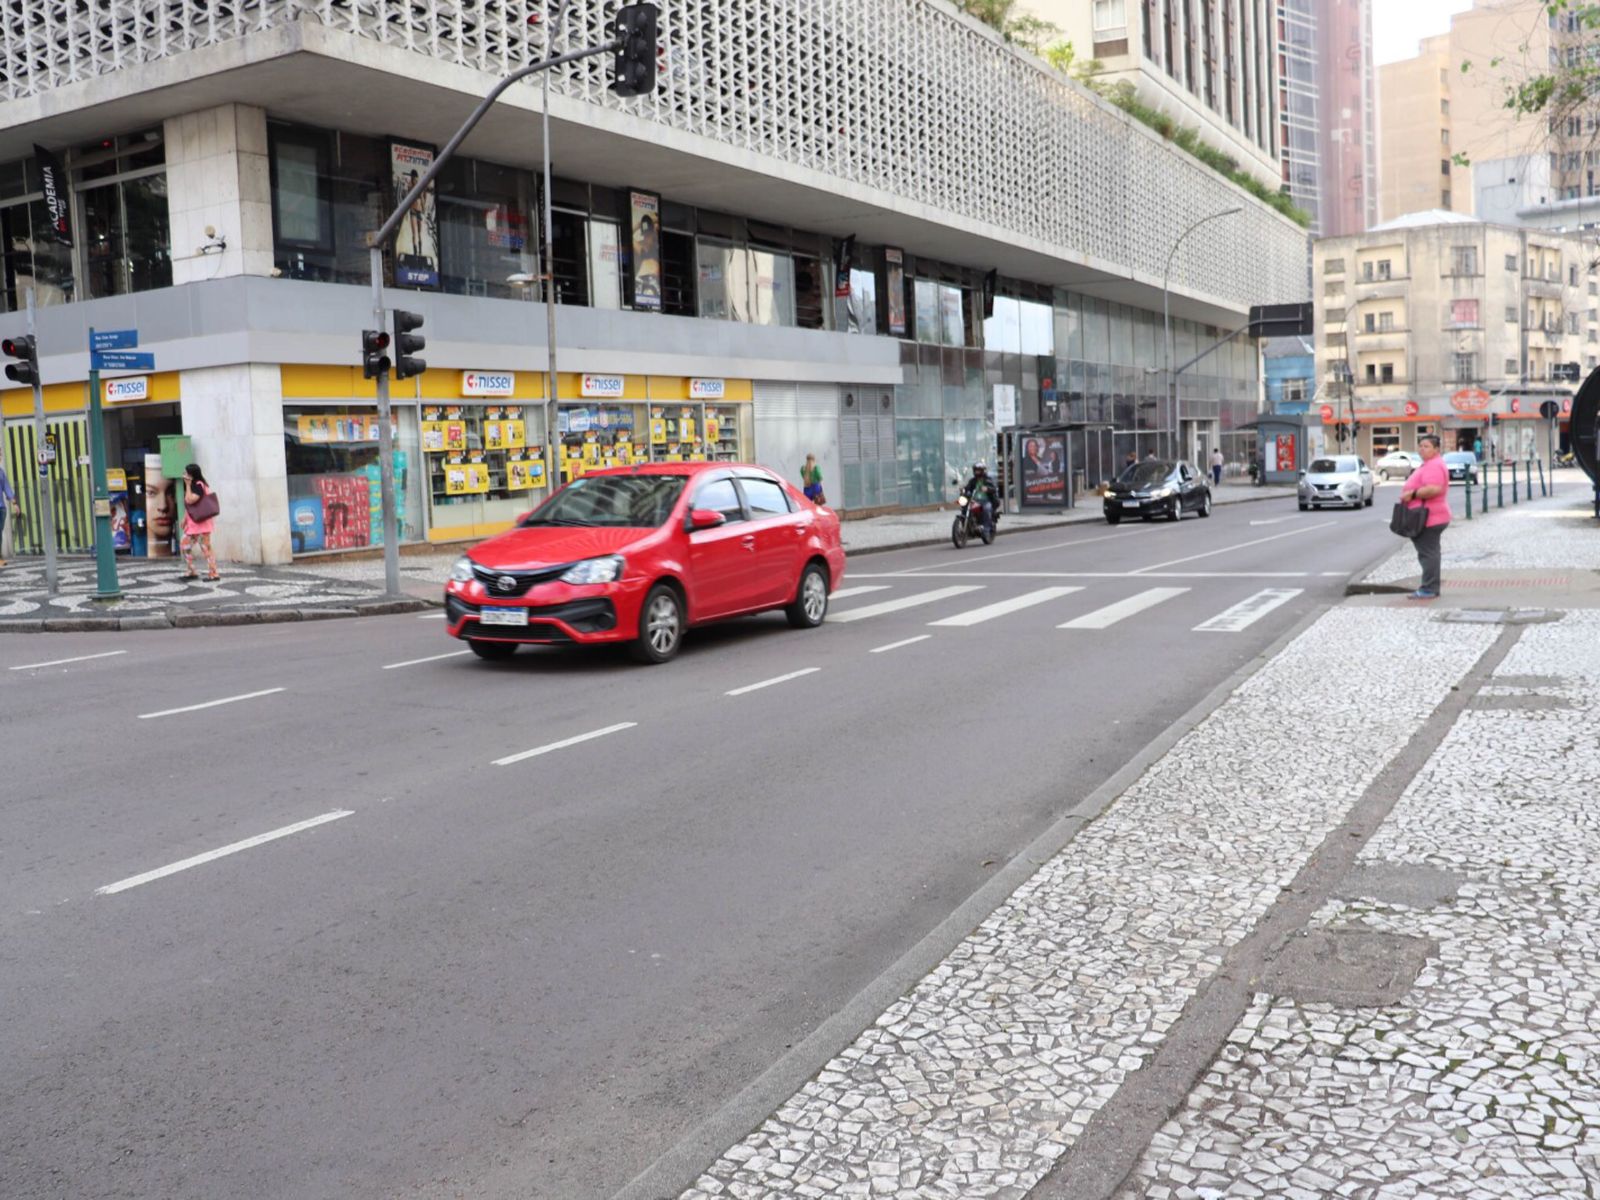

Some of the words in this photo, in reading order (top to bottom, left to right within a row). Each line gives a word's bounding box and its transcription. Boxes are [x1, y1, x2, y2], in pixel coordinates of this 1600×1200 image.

[42, 166, 59, 230] ACADEMIA
[407, 272, 430, 282] STEP
[117, 381, 144, 395] nissei
[479, 376, 511, 389] nissei
[594, 378, 621, 390] nissei
[699, 381, 722, 393] nissei
